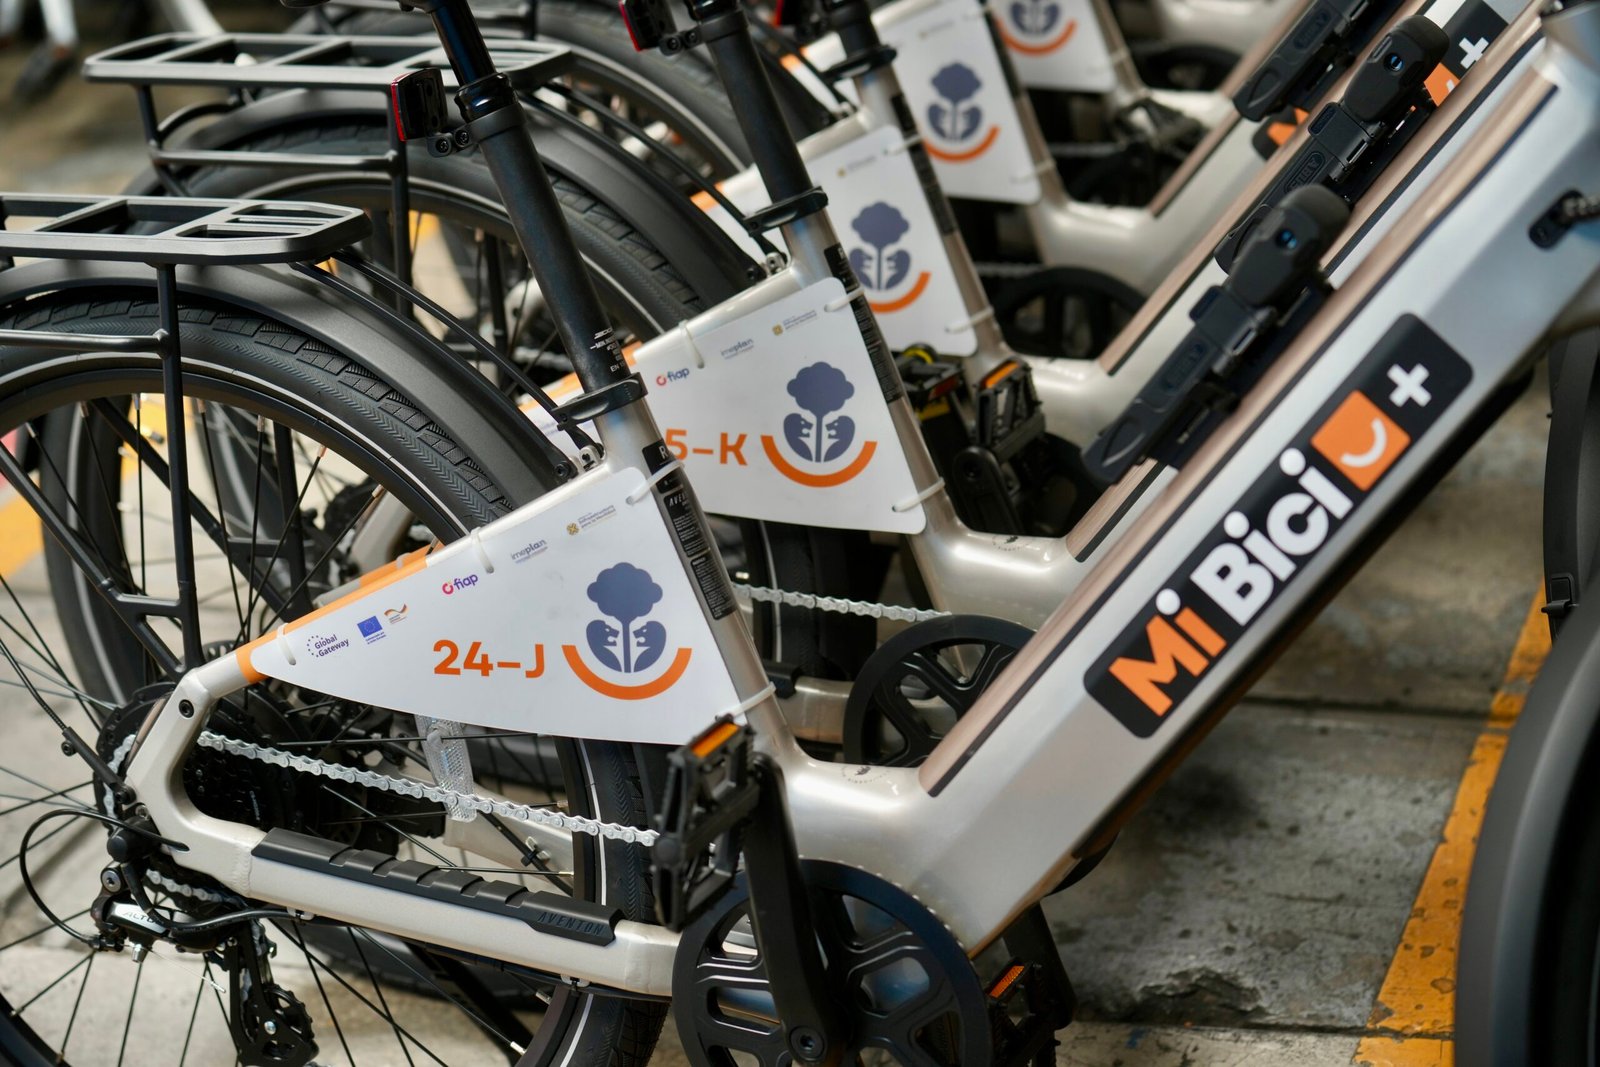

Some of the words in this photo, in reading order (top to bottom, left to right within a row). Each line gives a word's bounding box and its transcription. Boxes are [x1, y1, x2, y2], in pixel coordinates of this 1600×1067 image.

[1191, 449, 1351, 624] Bici
[453, 574, 479, 591] fiap
[314, 634, 338, 650] Global
[318, 638, 350, 657] Gateway
[537, 911, 605, 936] AVENTON
